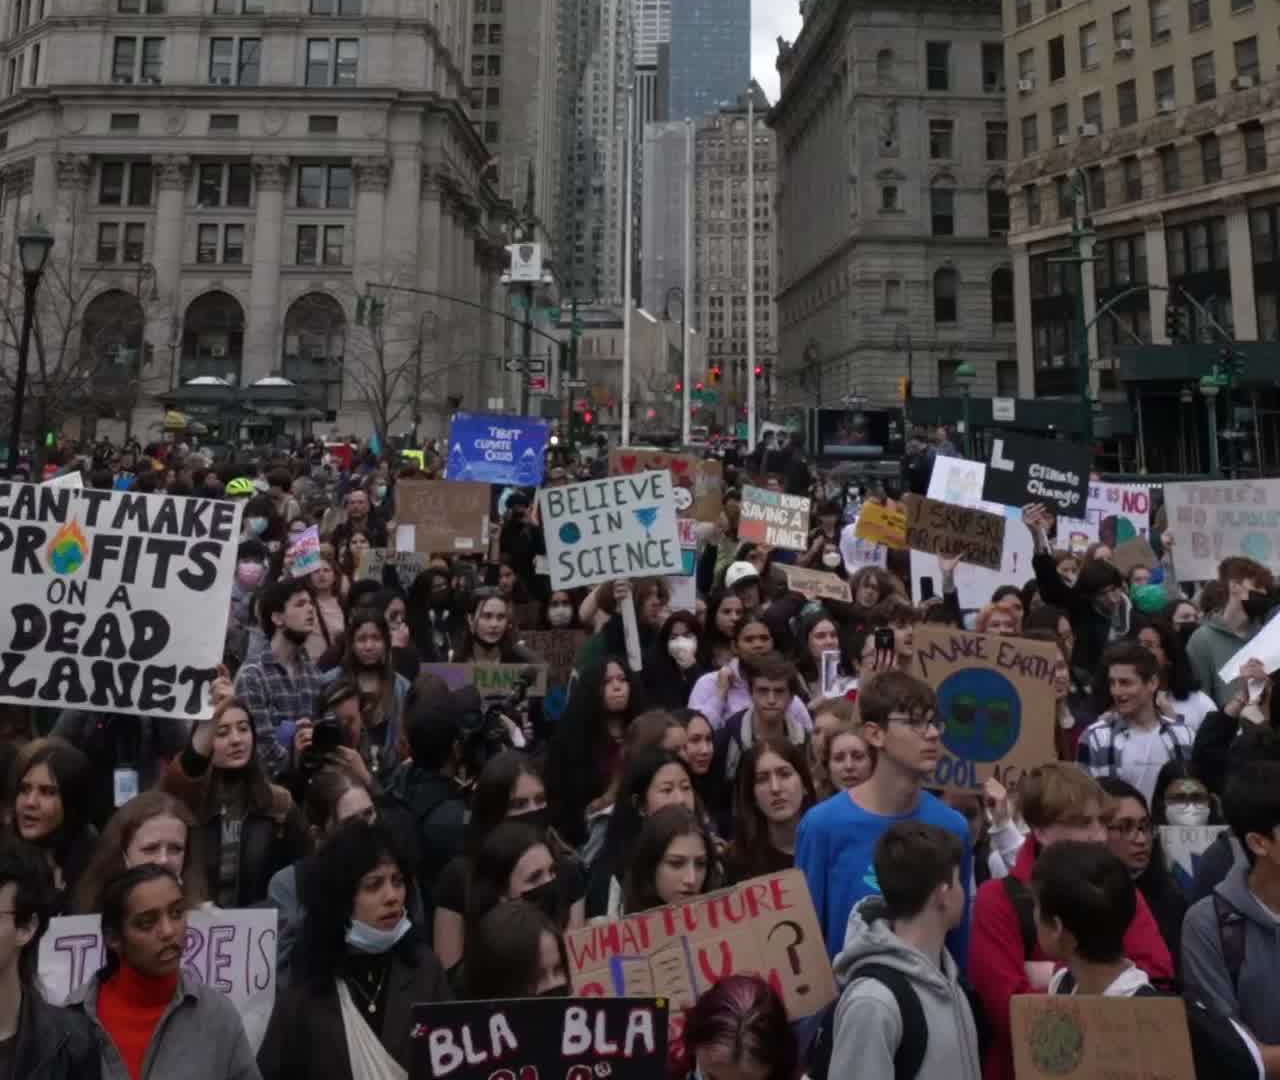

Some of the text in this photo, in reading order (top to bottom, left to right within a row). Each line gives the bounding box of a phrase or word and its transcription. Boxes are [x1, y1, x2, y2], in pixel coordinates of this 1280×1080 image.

[547, 473, 665, 519] BELIEVE
[1026, 479, 1081, 509] Change
[1028, 463, 1080, 486] Climate
[111, 493, 236, 542] MAKE
[588, 511, 623, 535] IN
[740, 500, 803, 529] SAVING A
[1121, 491, 1149, 515] NO
[558, 538, 675, 582] SCIENCE
[765, 526, 809, 551] PLANET
[46, 577, 132, 611] ON A
[10, 603, 171, 662] DEAD
[918, 636, 1056, 686] MAKE EARTH
[567, 877, 795, 971] WHAT FUTURE
[54, 924, 276, 997] TRE IS
[428, 1011, 519, 1078] BLA
[559, 1004, 658, 1058] BLA
